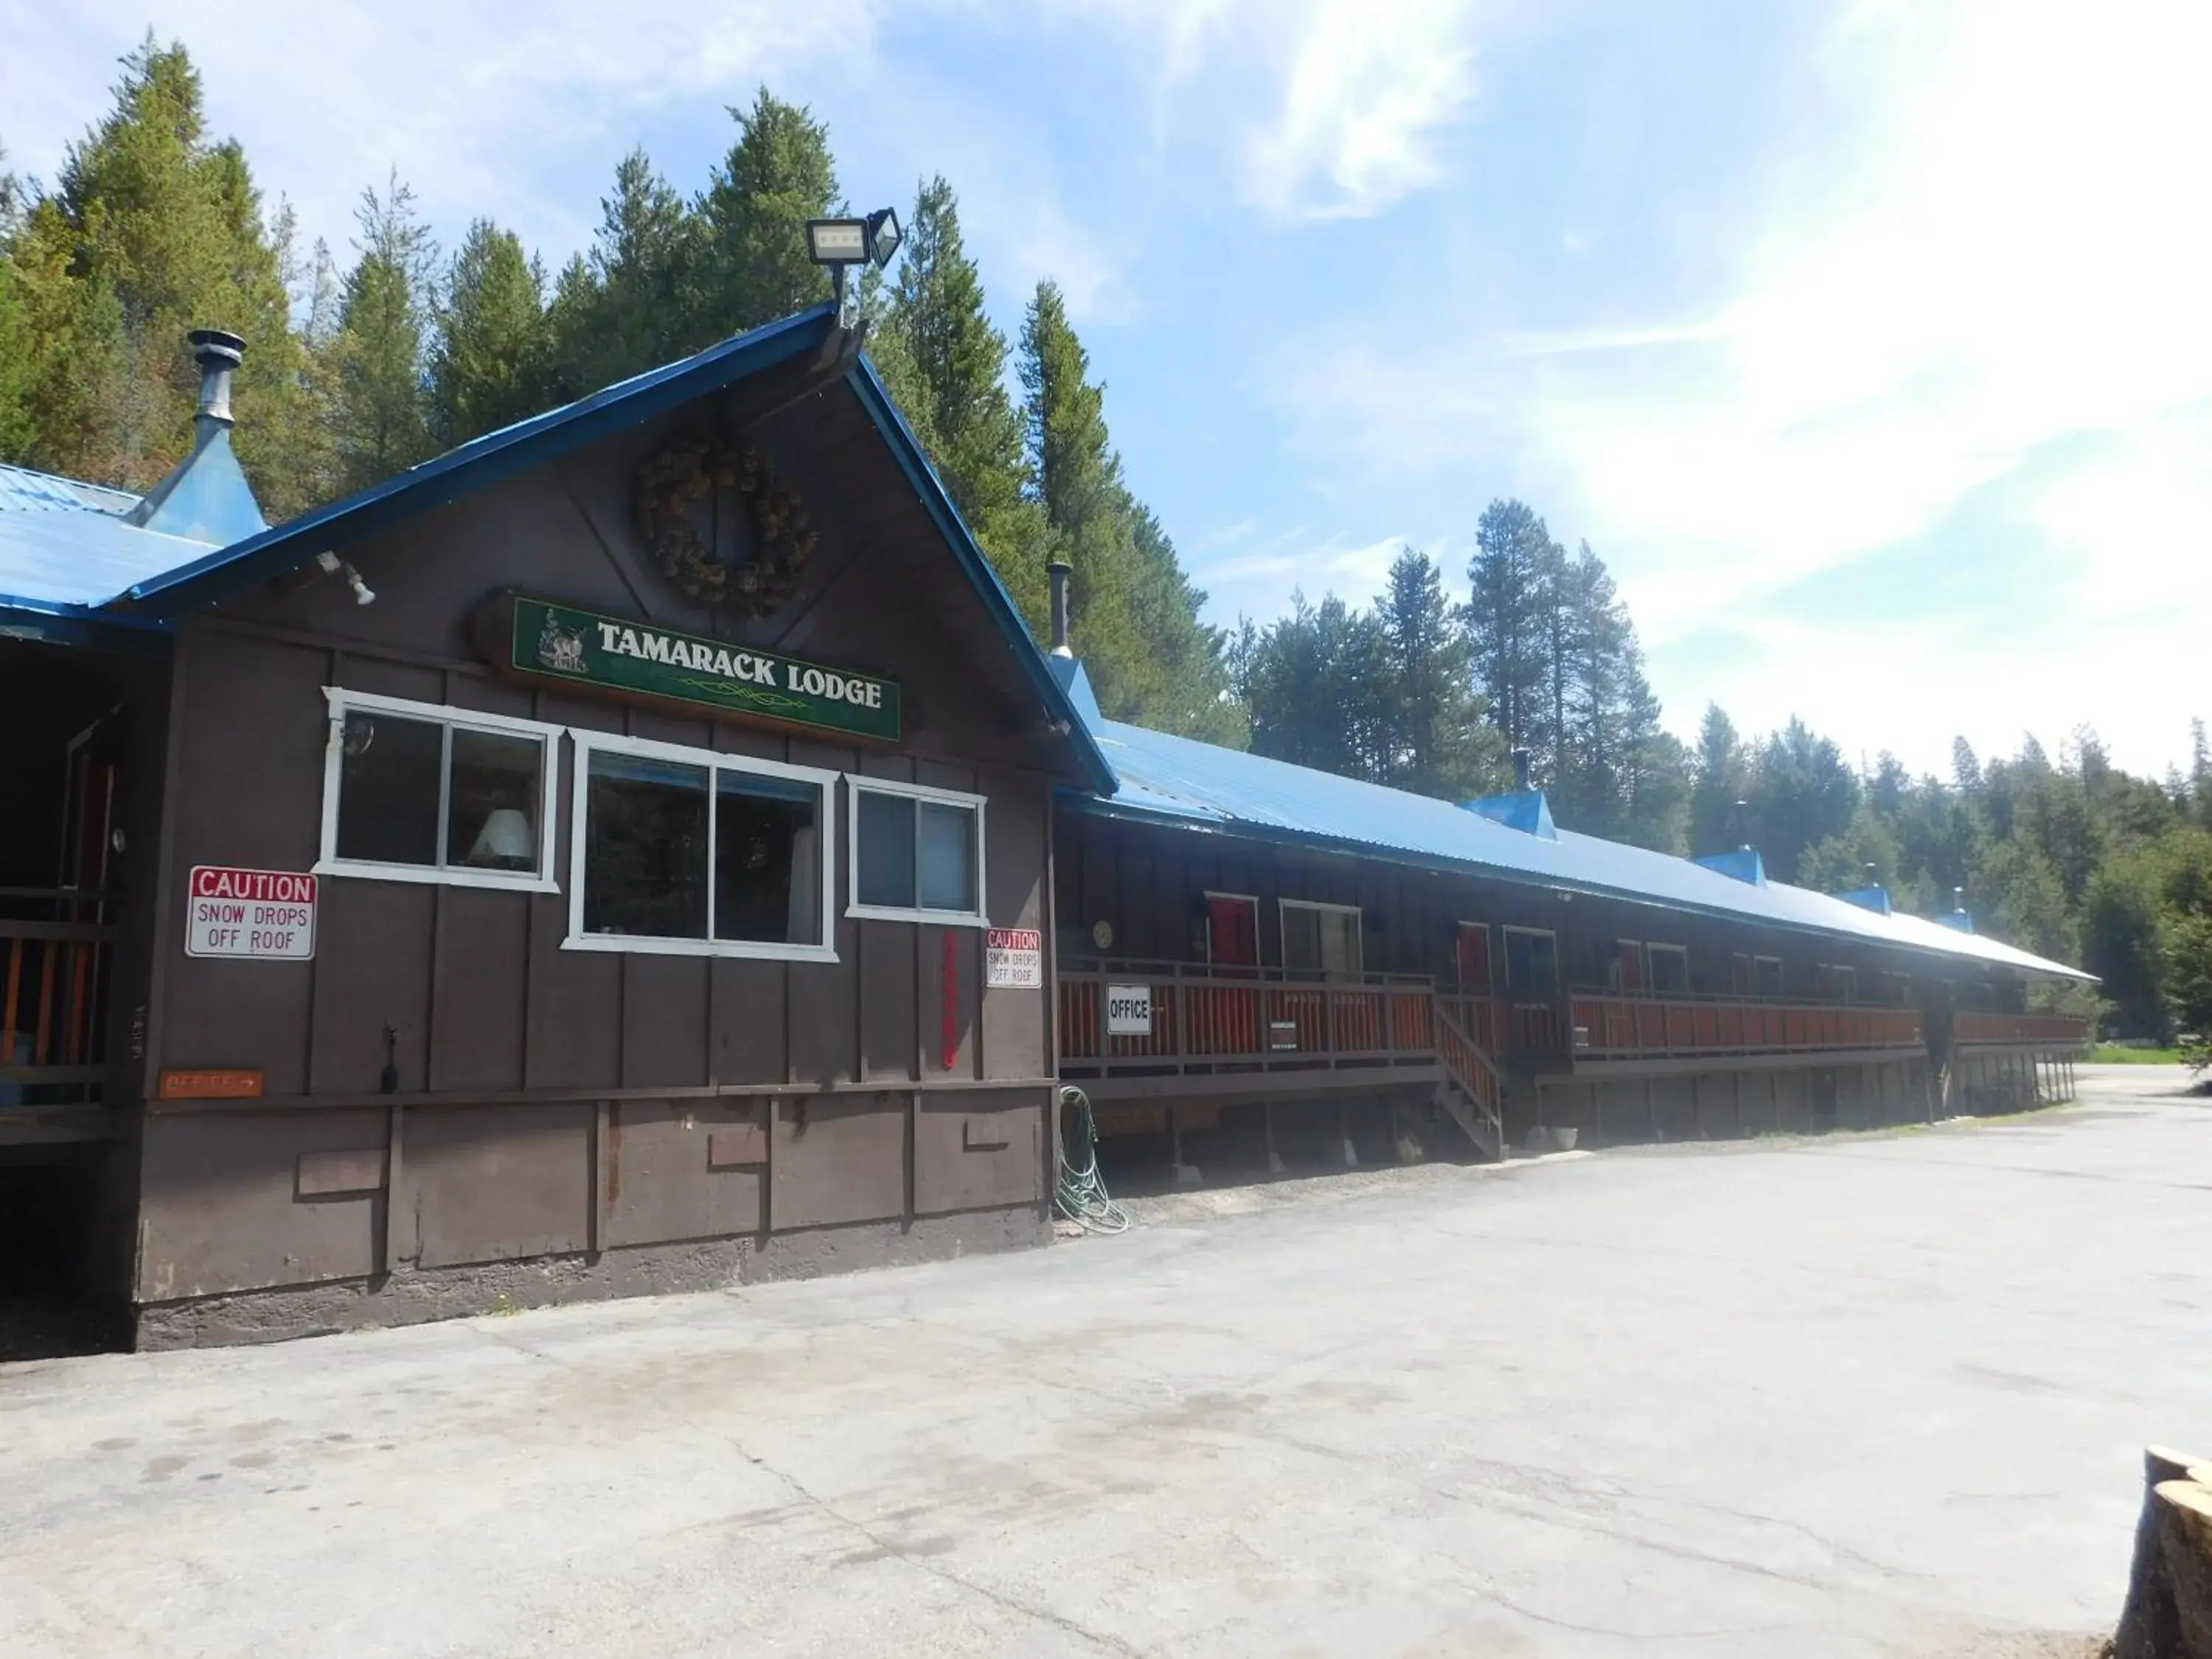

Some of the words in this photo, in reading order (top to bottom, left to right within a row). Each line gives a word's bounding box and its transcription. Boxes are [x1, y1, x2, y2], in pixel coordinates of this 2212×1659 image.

[598, 622, 776, 686] TAMARACK
[787, 666, 881, 709] LODGE
[199, 871, 310, 902] CAUTION
[198, 903, 245, 923] SNOW
[254, 907, 307, 927] DROPS
[208, 929, 240, 947] OFF
[251, 931, 295, 949] ROOF
[988, 931, 1037, 949] CAUTION
[1110, 1000, 1148, 1019] OFFICE
